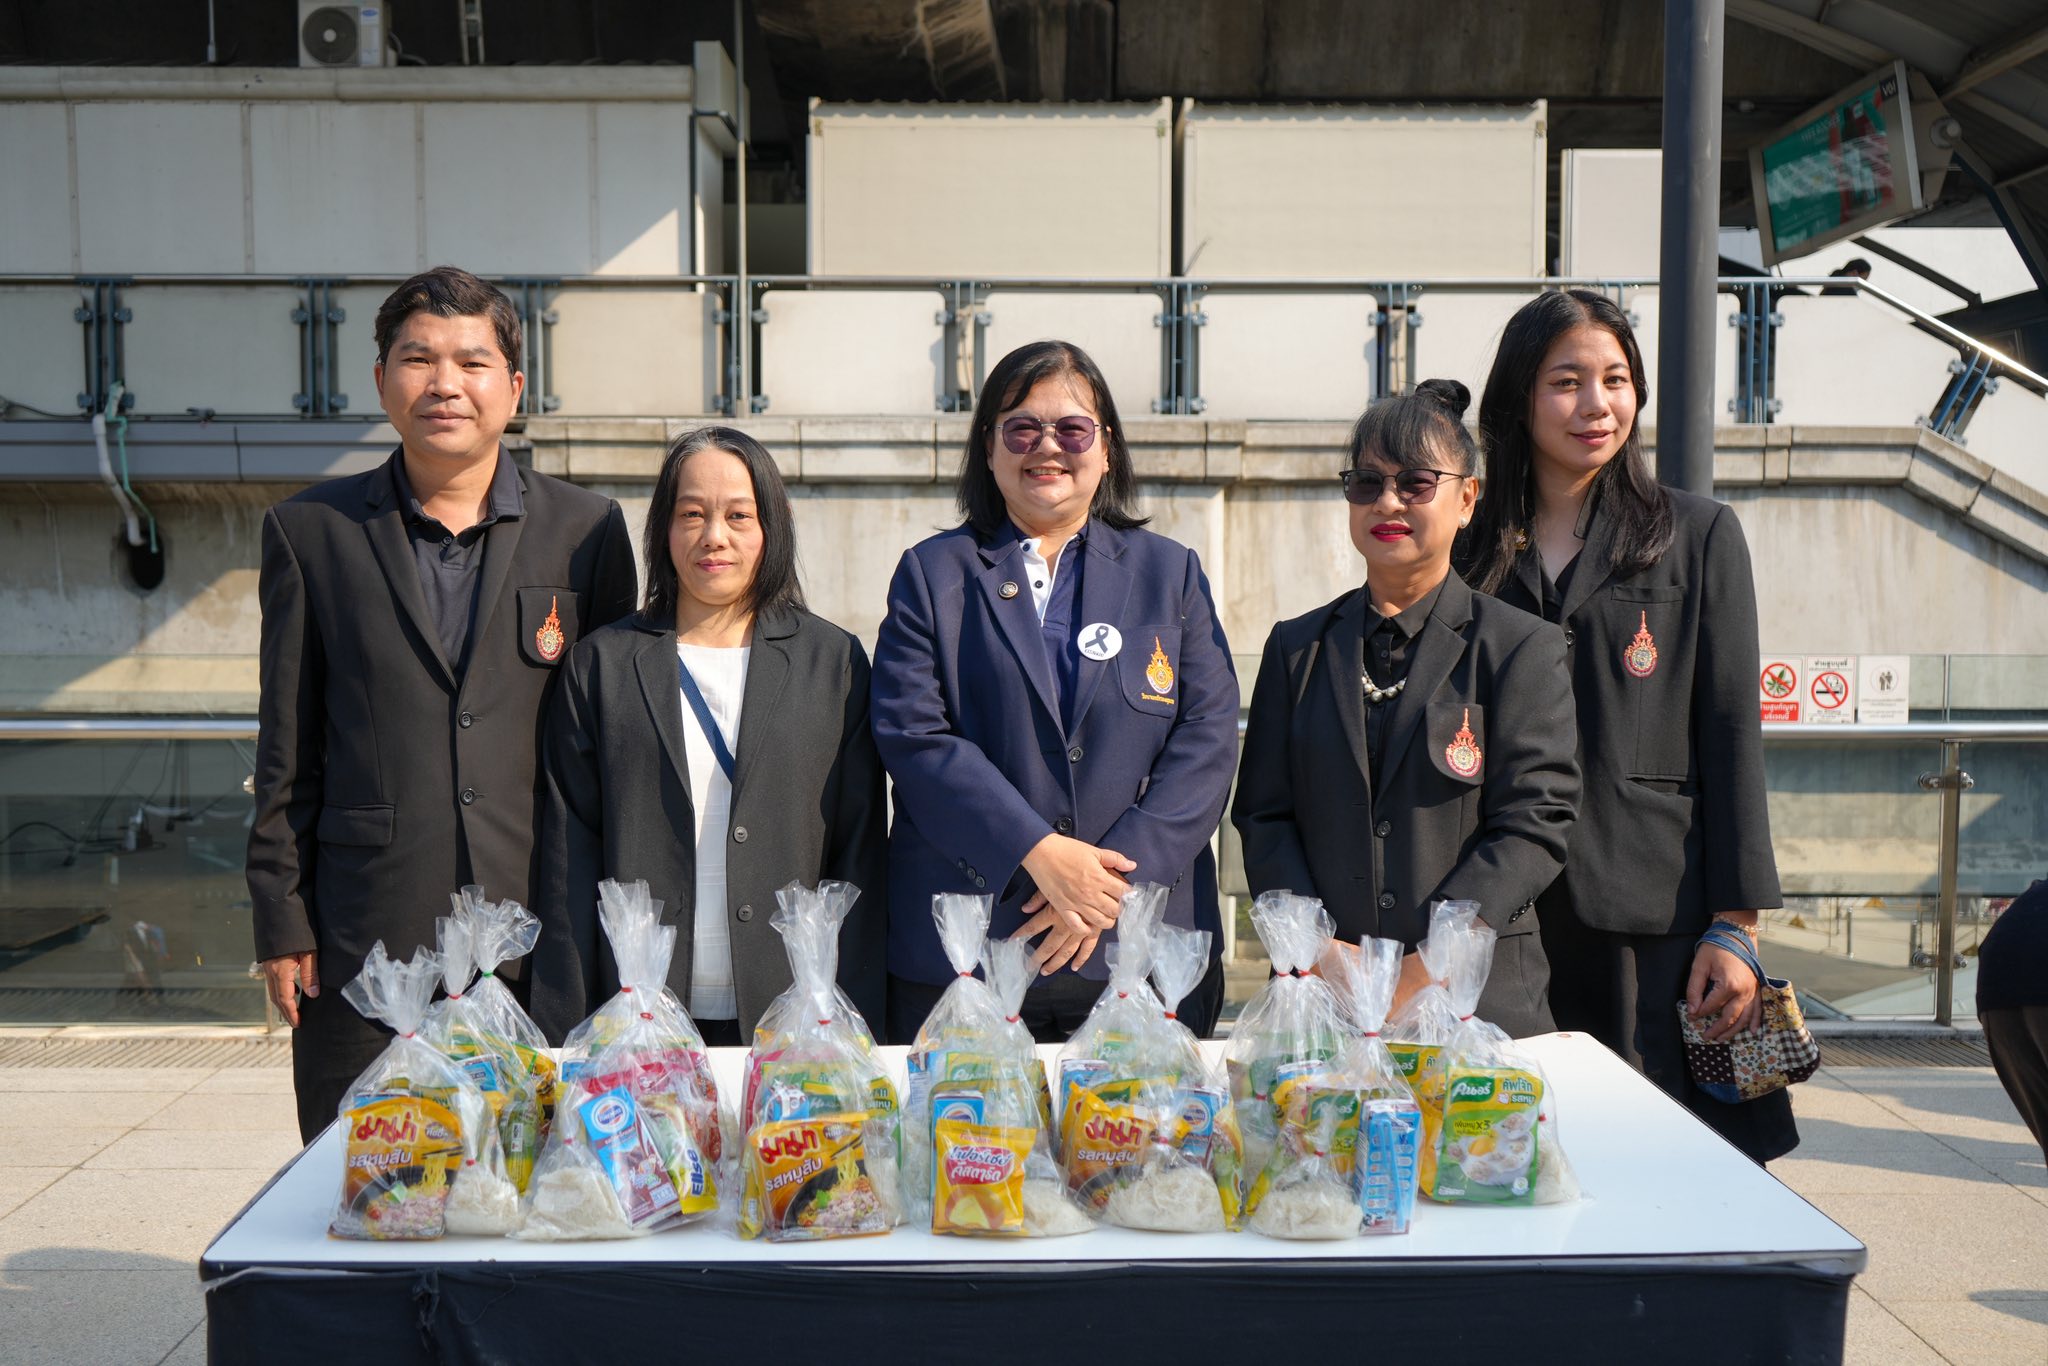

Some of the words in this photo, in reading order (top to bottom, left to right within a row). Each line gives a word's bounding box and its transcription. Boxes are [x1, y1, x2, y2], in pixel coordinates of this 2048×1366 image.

[356, 1111, 418, 1144] มาม่า
[1085, 1115, 1143, 1147] มาม่า
[348, 1148, 413, 1169] รสหมูสับ
[759, 1125, 818, 1164] มาม่า
[1078, 1148, 1137, 1165] รสหมูสับ
[764, 1157, 823, 1191] รสหมูสับ
